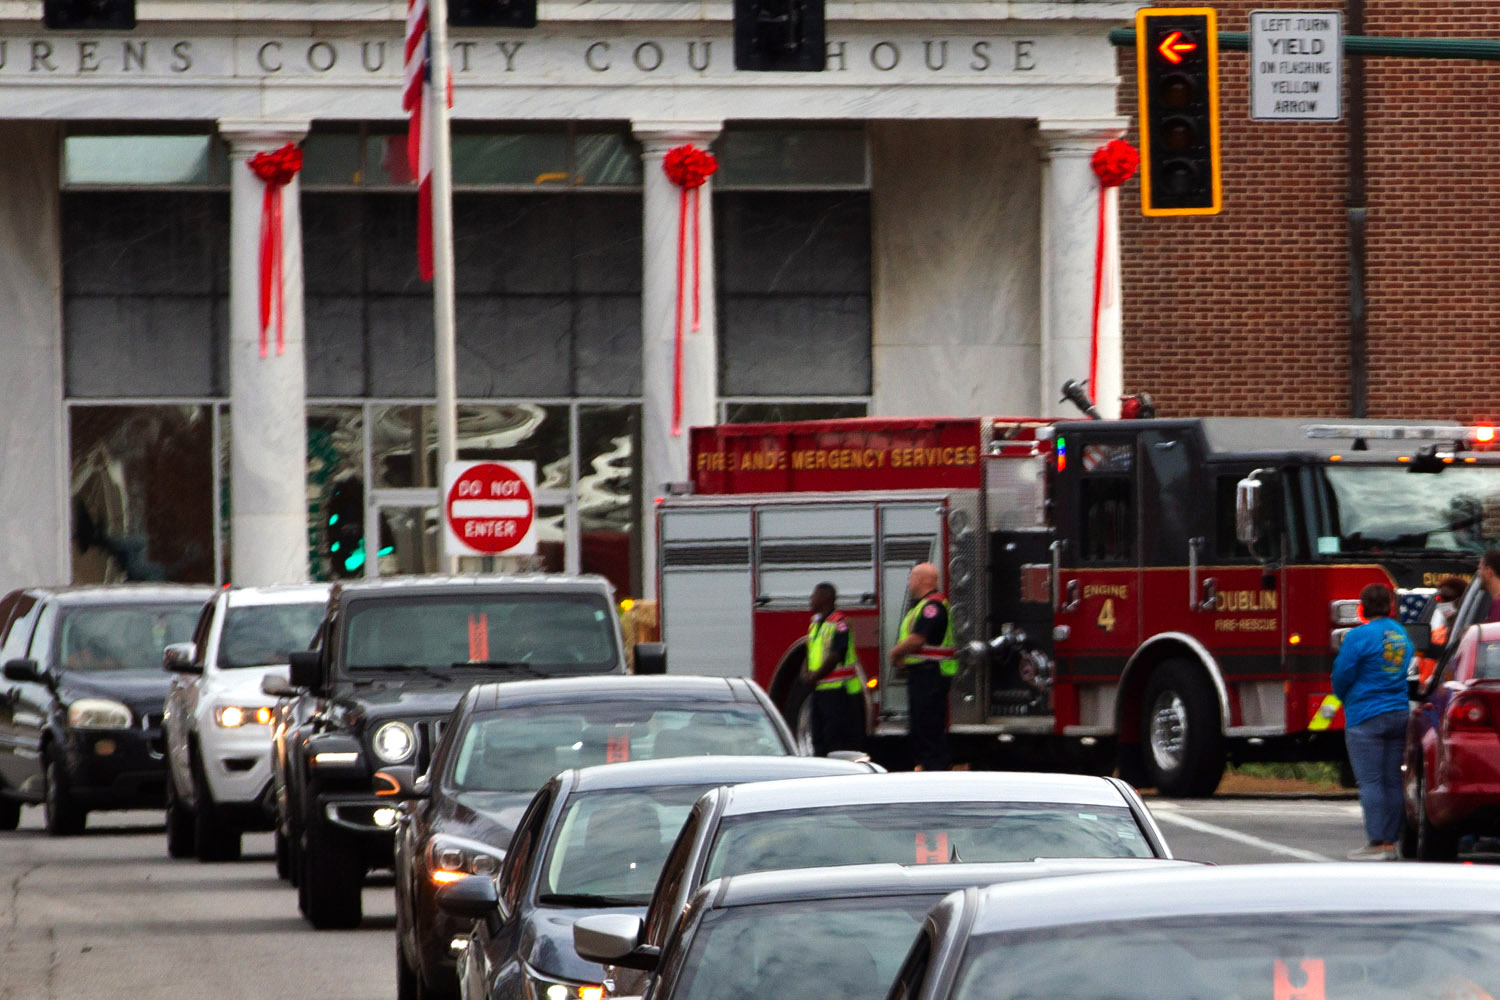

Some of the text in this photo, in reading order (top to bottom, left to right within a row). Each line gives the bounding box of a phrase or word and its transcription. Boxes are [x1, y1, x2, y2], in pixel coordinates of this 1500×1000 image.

[1261, 18, 1330, 31] LEFT TURN
[1267, 38, 1325, 55] YIELD
[256, 41, 525, 73] COUTY
[584, 41, 1037, 72] COUHOUSE
[1260, 61, 1332, 74] ON FLASHING
[1271, 81, 1320, 94] YELLOW
[1273, 100, 1317, 113] ARROW
[697, 451, 736, 472] FIRE
[741, 450, 779, 471] AND
[890, 446, 977, 469] SERVICES
[458, 480, 521, 497] DO NOT
[464, 520, 518, 537] ENTER
[1083, 584, 1128, 599] ENGINE
[1215, 590, 1278, 612] DUBLIN
[1096, 598, 1117, 634] 4
[1214, 618, 1278, 632] FIRE-RESCUE
